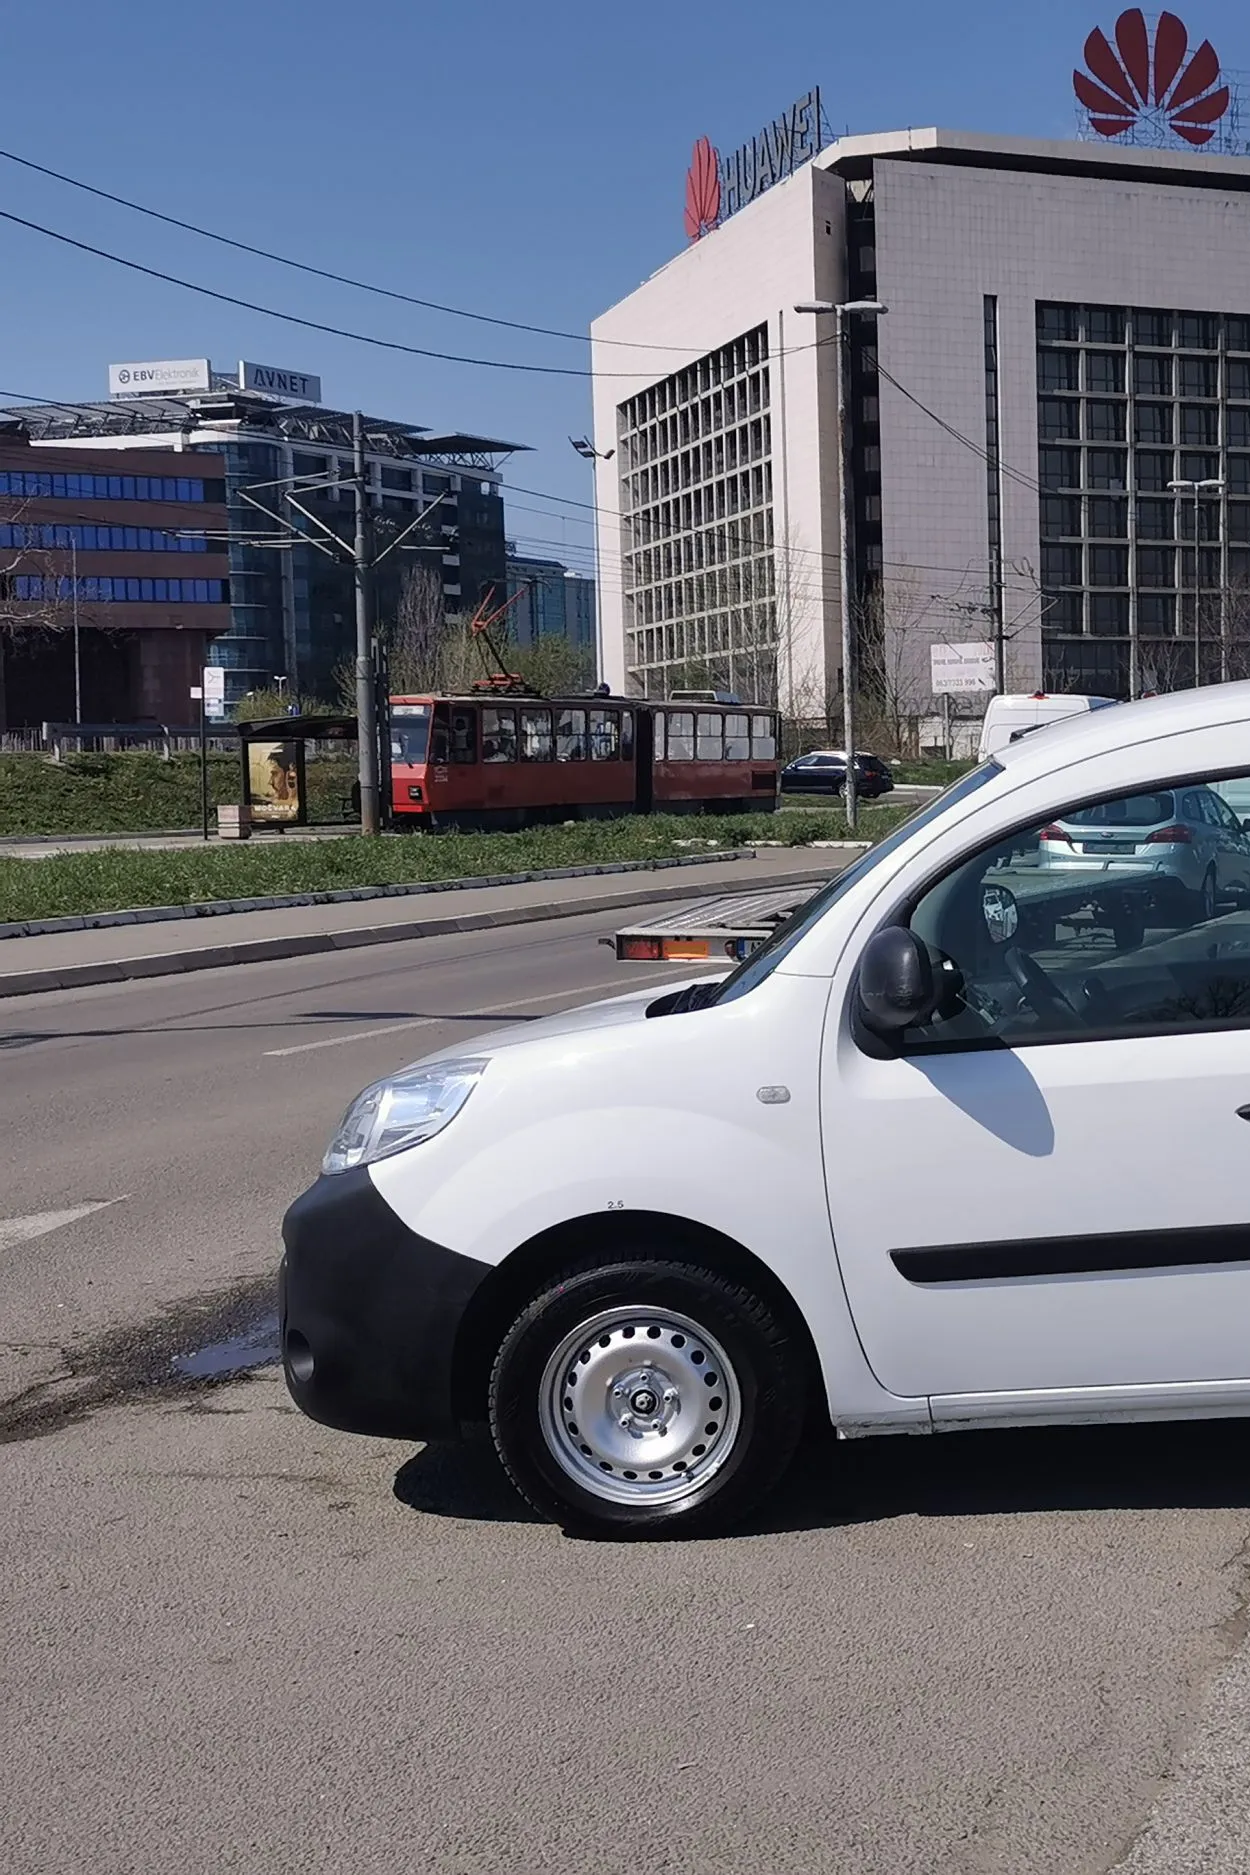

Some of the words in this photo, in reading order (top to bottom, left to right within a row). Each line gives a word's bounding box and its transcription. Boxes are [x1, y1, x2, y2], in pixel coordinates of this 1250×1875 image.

[725, 85, 821, 215] HUAWEI
[253, 368, 309, 394] AVNET
[607, 1200, 624, 1209] 2.5
